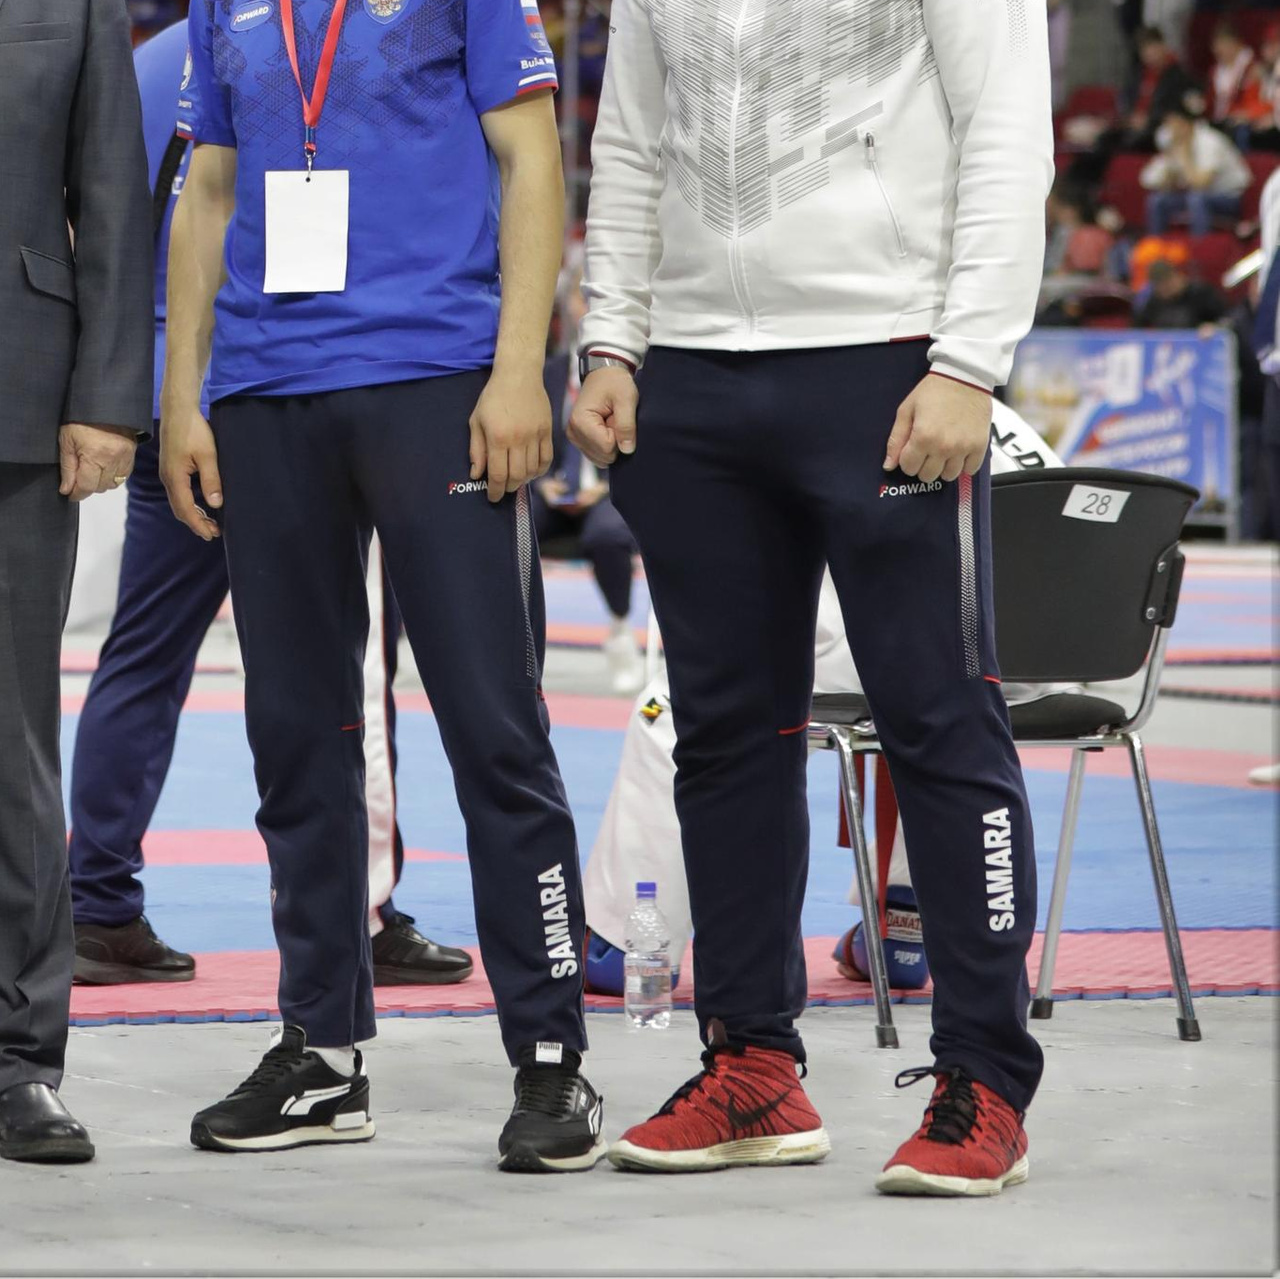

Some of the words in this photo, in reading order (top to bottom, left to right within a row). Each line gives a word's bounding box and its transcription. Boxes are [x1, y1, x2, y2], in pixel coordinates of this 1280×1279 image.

[233, 6, 269, 26] FORWARD
[448, 481, 489, 495] FORWA
[879, 481, 942, 498] FORWARD
[1081, 492, 1112, 516] 28
[982, 807, 1016, 932] SAMARA
[537, 862, 578, 979] SAMARA
